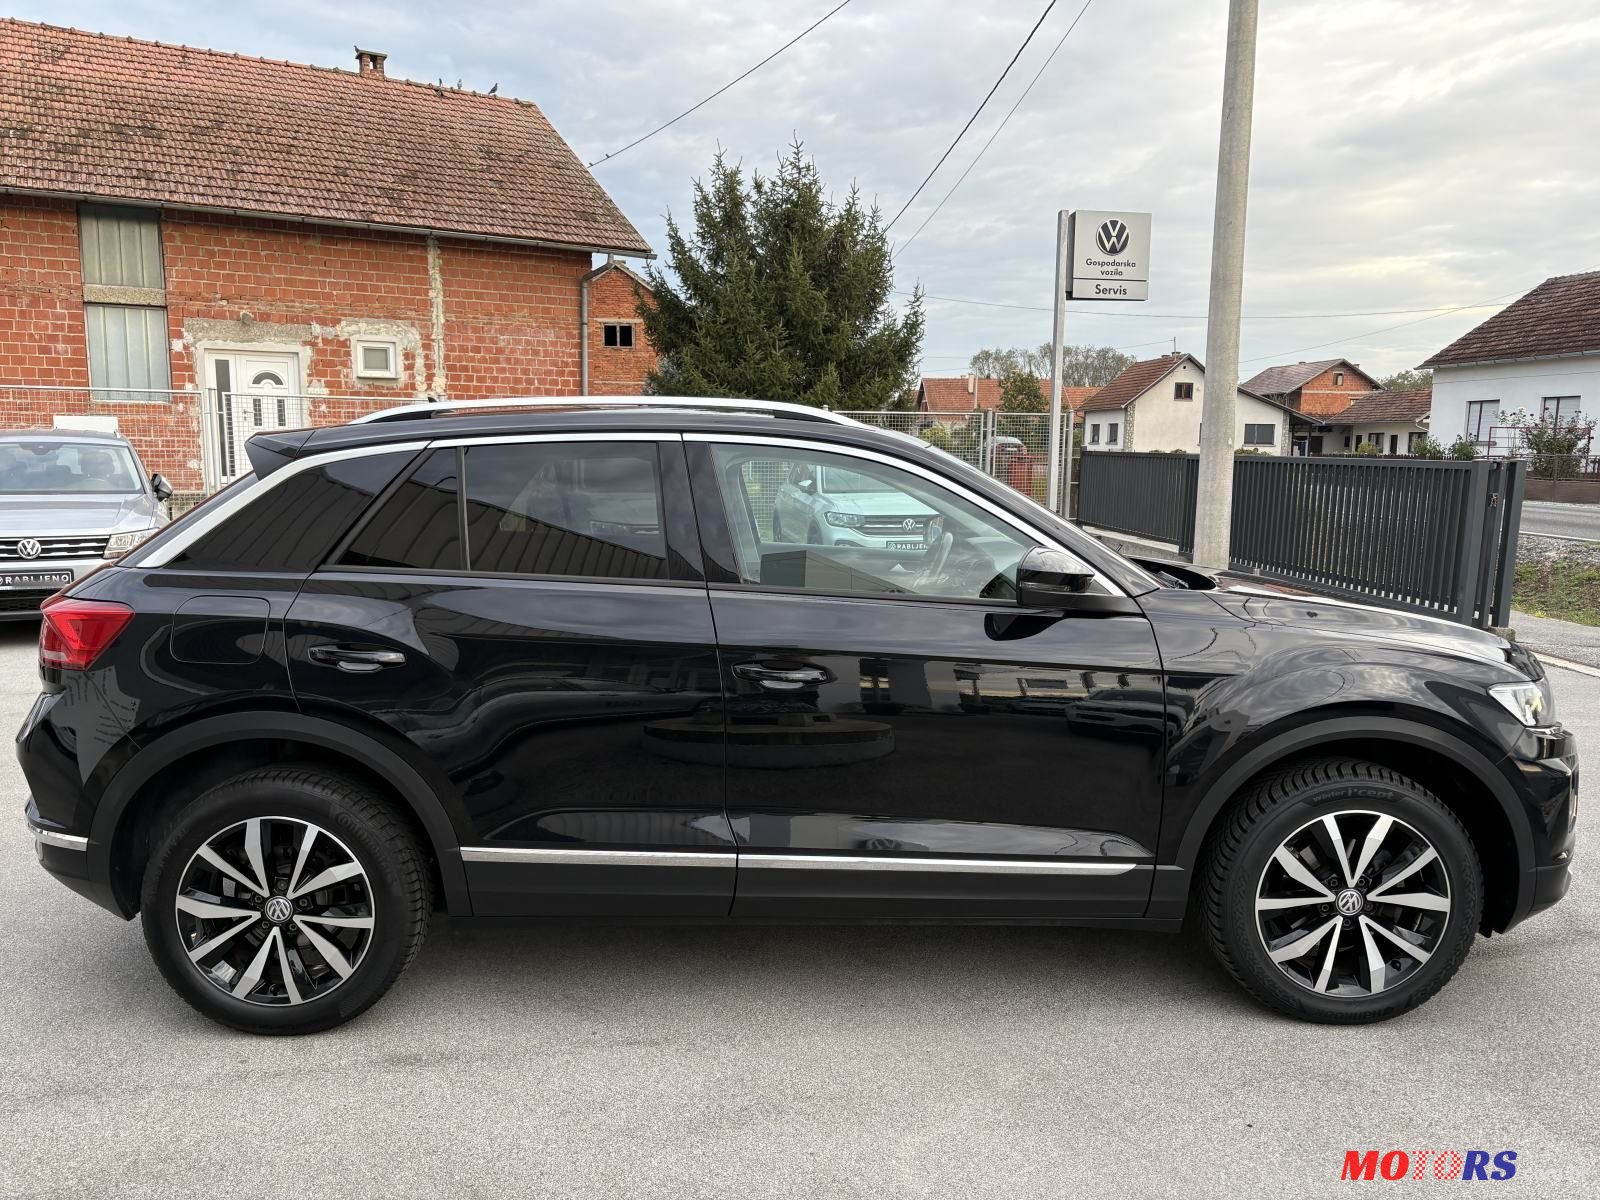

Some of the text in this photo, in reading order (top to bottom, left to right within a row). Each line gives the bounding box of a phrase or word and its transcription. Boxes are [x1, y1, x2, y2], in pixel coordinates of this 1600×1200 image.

[1085, 258, 1136, 268] Gospodarska
[1100, 268, 1123, 276] vozila
[1095, 283, 1128, 295] Servis
[5, 574, 69, 585] RABLJENO
